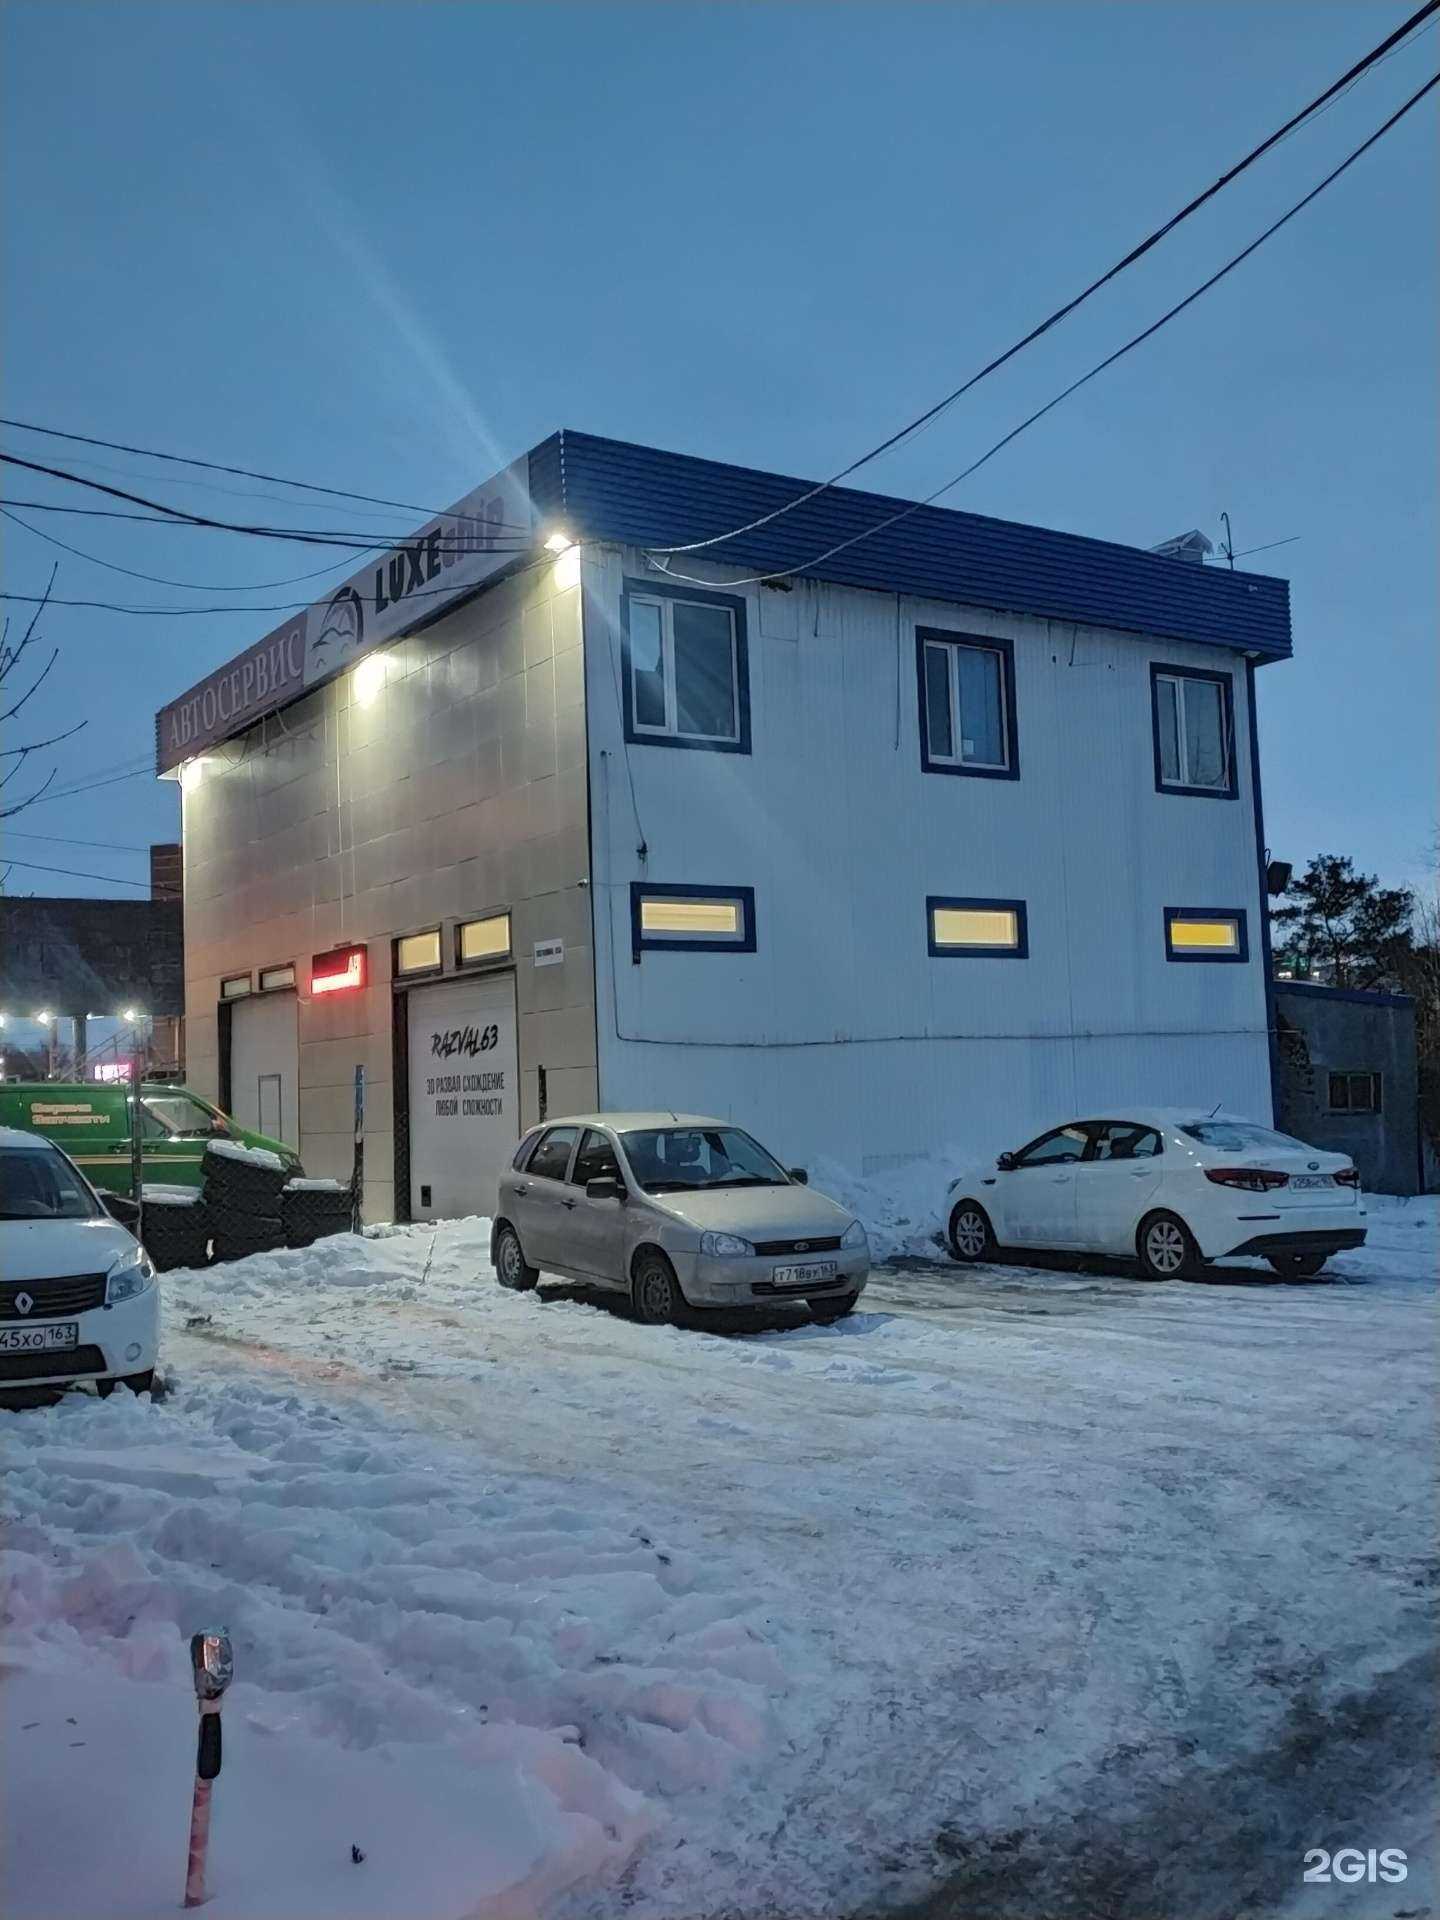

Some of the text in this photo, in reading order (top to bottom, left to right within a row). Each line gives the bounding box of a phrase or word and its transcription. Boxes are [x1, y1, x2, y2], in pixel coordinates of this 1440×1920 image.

[169, 629, 302, 750] АВТОСЕРВИС
[431, 1024, 499, 1057] RAZVAL63
[436, 1075, 461, 1093] РАЗВАЛ
[463, 1072, 505, 1092] СХОЖДЕНИЕ
[435, 1097, 503, 1116] ЛЮБОЙ СЛОЖНОСТИ
[48, 1327, 72, 1340] 163
